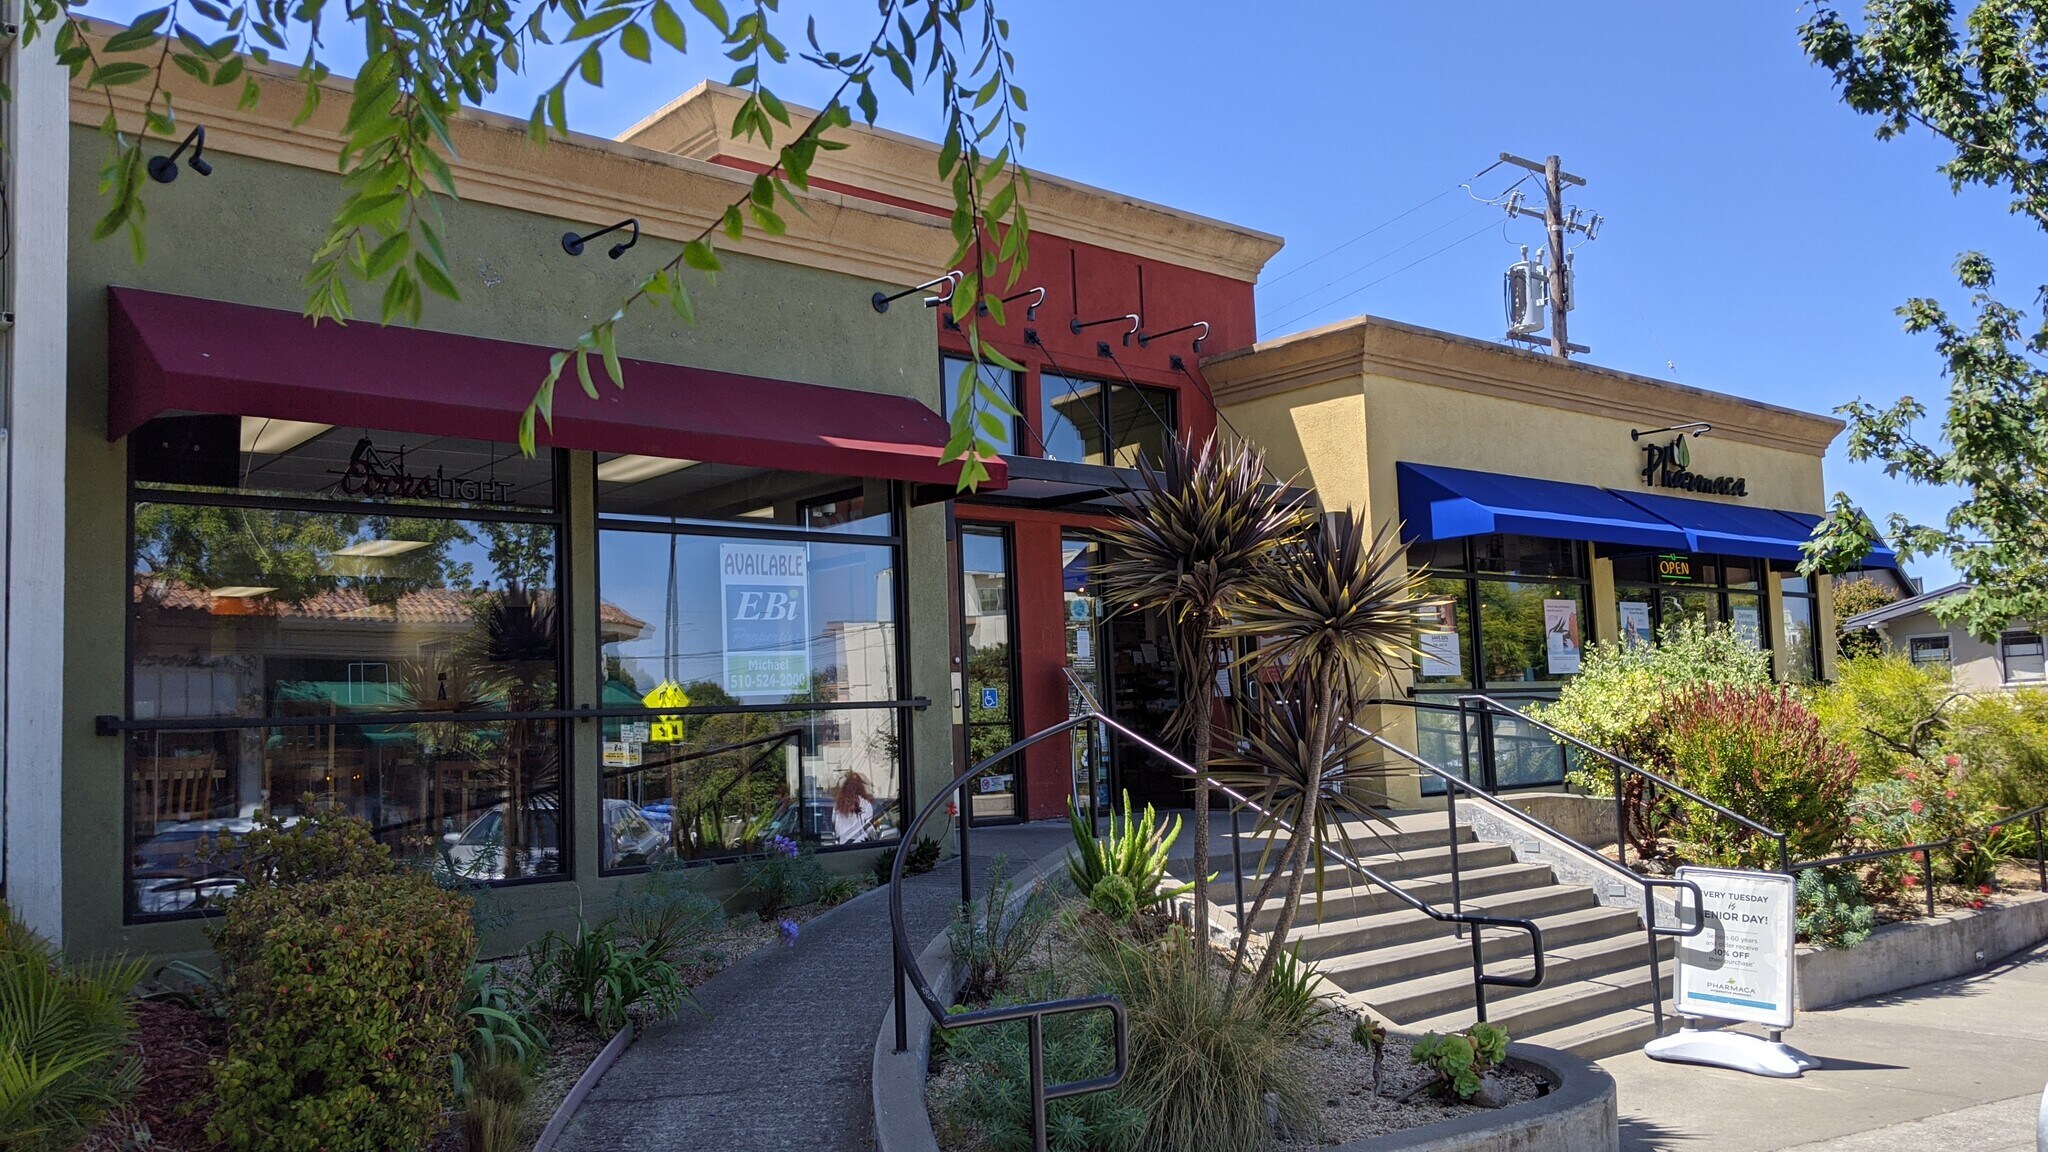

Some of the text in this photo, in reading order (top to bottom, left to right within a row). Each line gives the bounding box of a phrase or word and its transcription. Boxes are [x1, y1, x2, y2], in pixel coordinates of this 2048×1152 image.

[341, 459, 512, 501] Coors LIGHT
[724, 553, 804, 577] AVAILABLE
[1660, 560, 1690, 575] OPEN
[732, 589, 799, 621] EBi
[748, 658, 789, 671] Michael
[730, 673, 806, 689] 510-524-2000
[1702, 890, 1769, 903] VERY TUESDAY
[1728, 901, 1737, 911] is
[1704, 910, 1768, 925] ENIOR DAY!
[1732, 951, 1750, 959] OFF
[1706, 982, 1756, 994] PHARMACA
